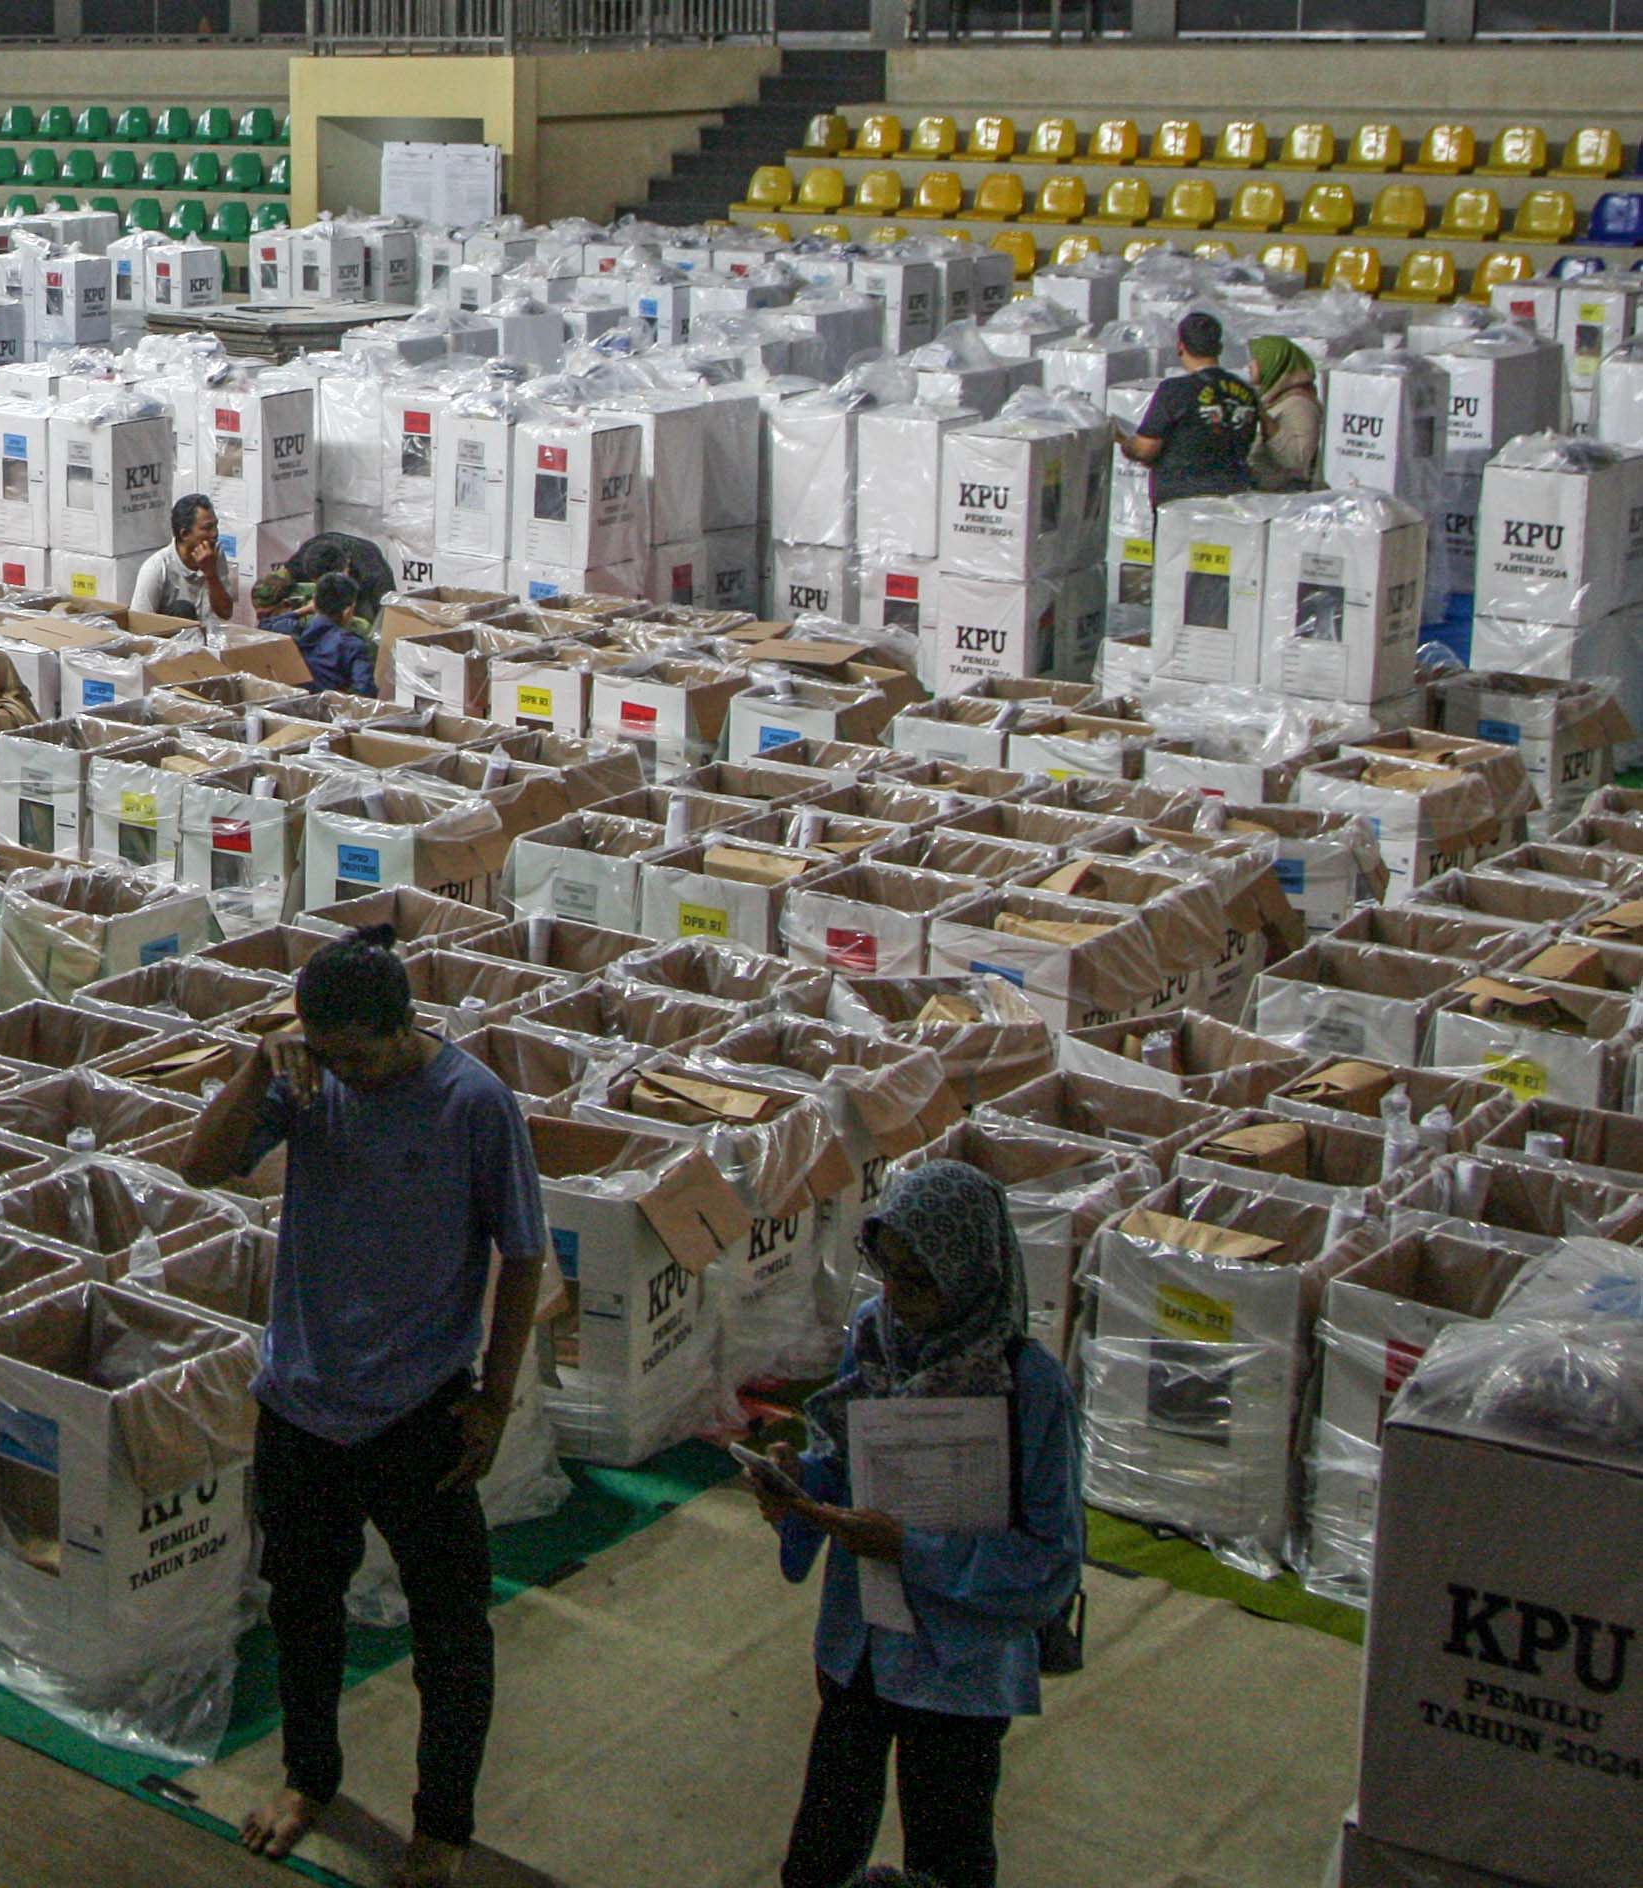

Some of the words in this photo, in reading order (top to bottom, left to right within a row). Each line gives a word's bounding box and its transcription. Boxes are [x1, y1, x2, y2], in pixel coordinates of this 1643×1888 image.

[83, 288, 106, 302] KPU
[190, 277, 214, 293] KPU
[1342, 413, 1384, 439] KPU
[272, 433, 305, 459] KPU
[125, 462, 162, 490] KPU
[600, 473, 634, 501] KPU
[959, 483, 1010, 510] KPU
[953, 524, 986, 537] TAHUN
[988, 527, 1014, 538] 2024
[965, 513, 1003, 525] PEMILU
[1502, 521, 1565, 551] KPU
[1493, 562, 1536, 580] TAHUN
[1538, 567, 1569, 581] 2024
[1509, 552, 1556, 567] PEMILU
[789, 585, 829, 612] KPU
[956, 626, 1007, 655] KPU
[1561, 749, 1594, 784] KPU
[683, 915, 706, 931] DPR
[708, 918, 723, 932] RI
[1490, 1069, 1520, 1086] DPR
[1523, 1072, 1541, 1089] RI
[748, 1212, 799, 1262] KPU
[648, 1260, 690, 1323] KPU
[149, 1516, 210, 1558] PEMILU
[128, 1553, 185, 1591] TAHUN
[188, 1532, 228, 1570] 2024
[1443, 1582, 1636, 1695] KPU
[1465, 1678, 1605, 1734] PEMILU
[1419, 1700, 1545, 1755] TAHUN
[1553, 1738, 1643, 1781] 2024
